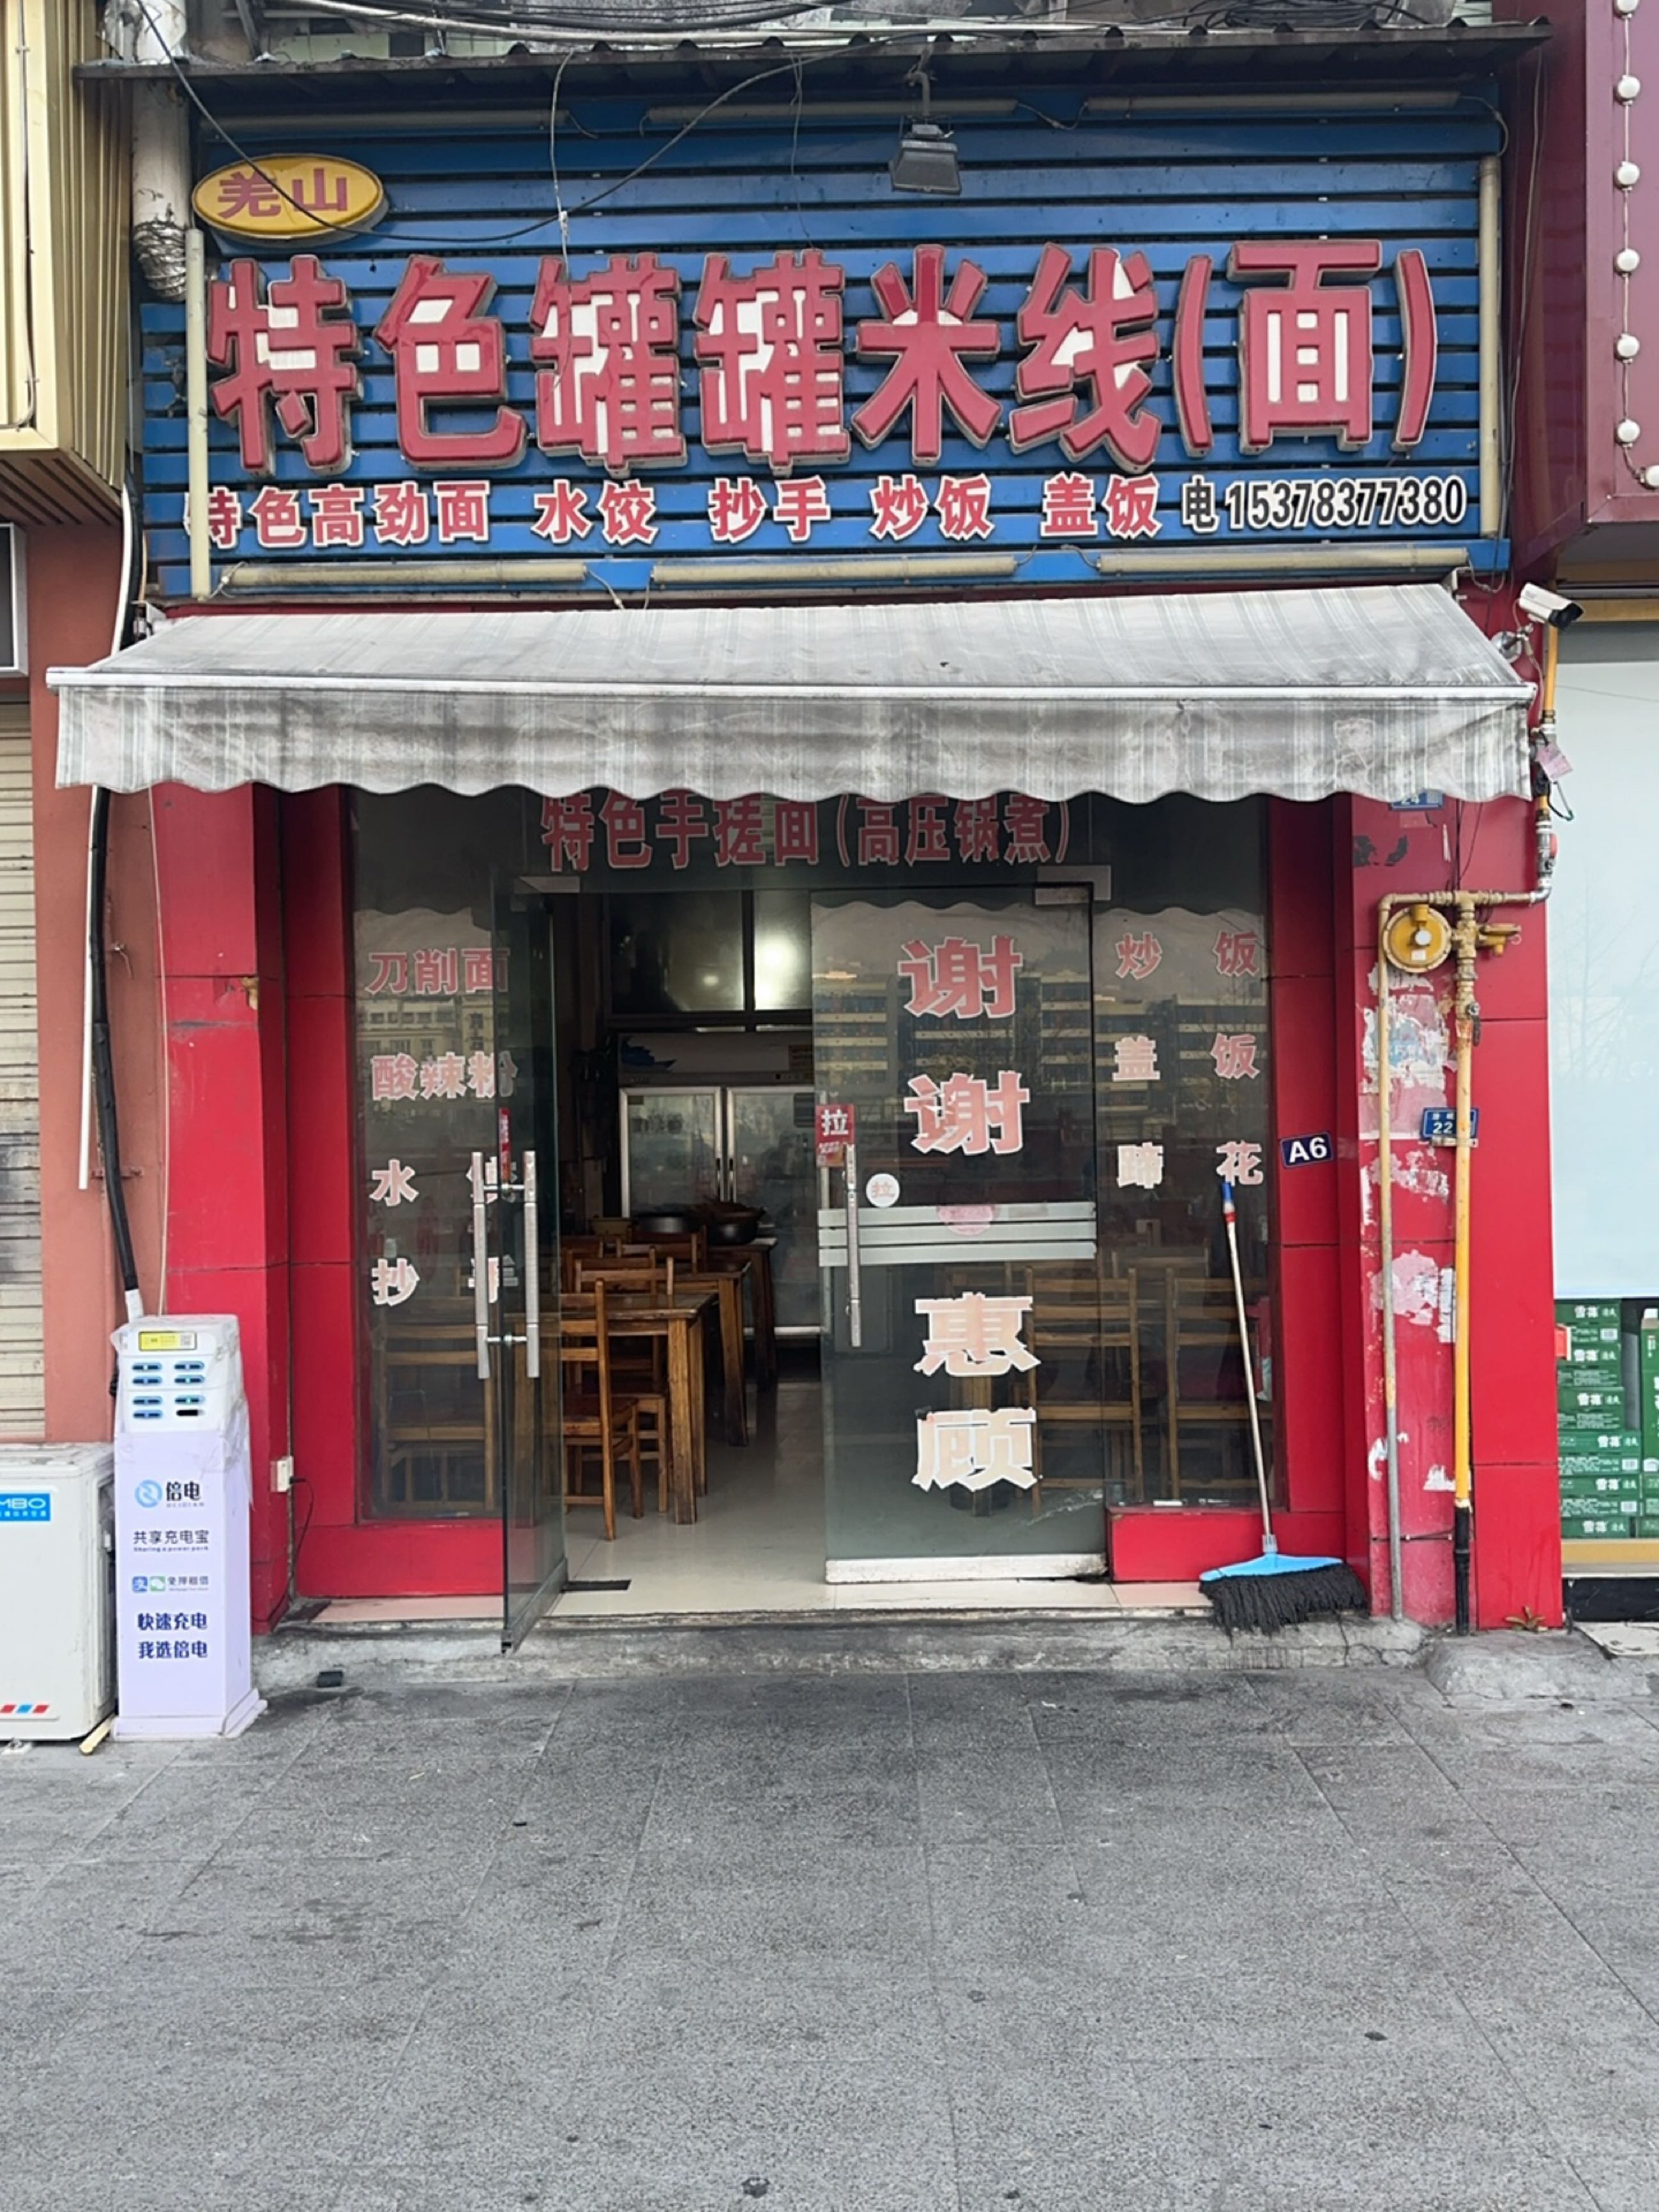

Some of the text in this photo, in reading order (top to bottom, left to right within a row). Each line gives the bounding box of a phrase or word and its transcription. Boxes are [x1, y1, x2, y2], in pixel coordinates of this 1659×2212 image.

[207, 239, 1438, 479] 特色罐罐米线(面)
[532, 479, 656, 545] 水饺
[707, 474, 830, 543] 抄手
[869, 474, 995, 540] 炒饭
[1040, 471, 1160, 539] 盖饭
[365, 948, 510, 995] 刀削面
[371, 1050, 518, 1100] 酸辣粉
[821, 1109, 849, 1137] 拉
[1289, 1136, 1327, 1164] A6
[166, 1480, 201, 1502] 倍电
[133, 1530, 209, 1544] 共享充电宝
[138, 1613, 207, 1630] 快速充电
[138, 1640, 207, 1658] 我选倍电
